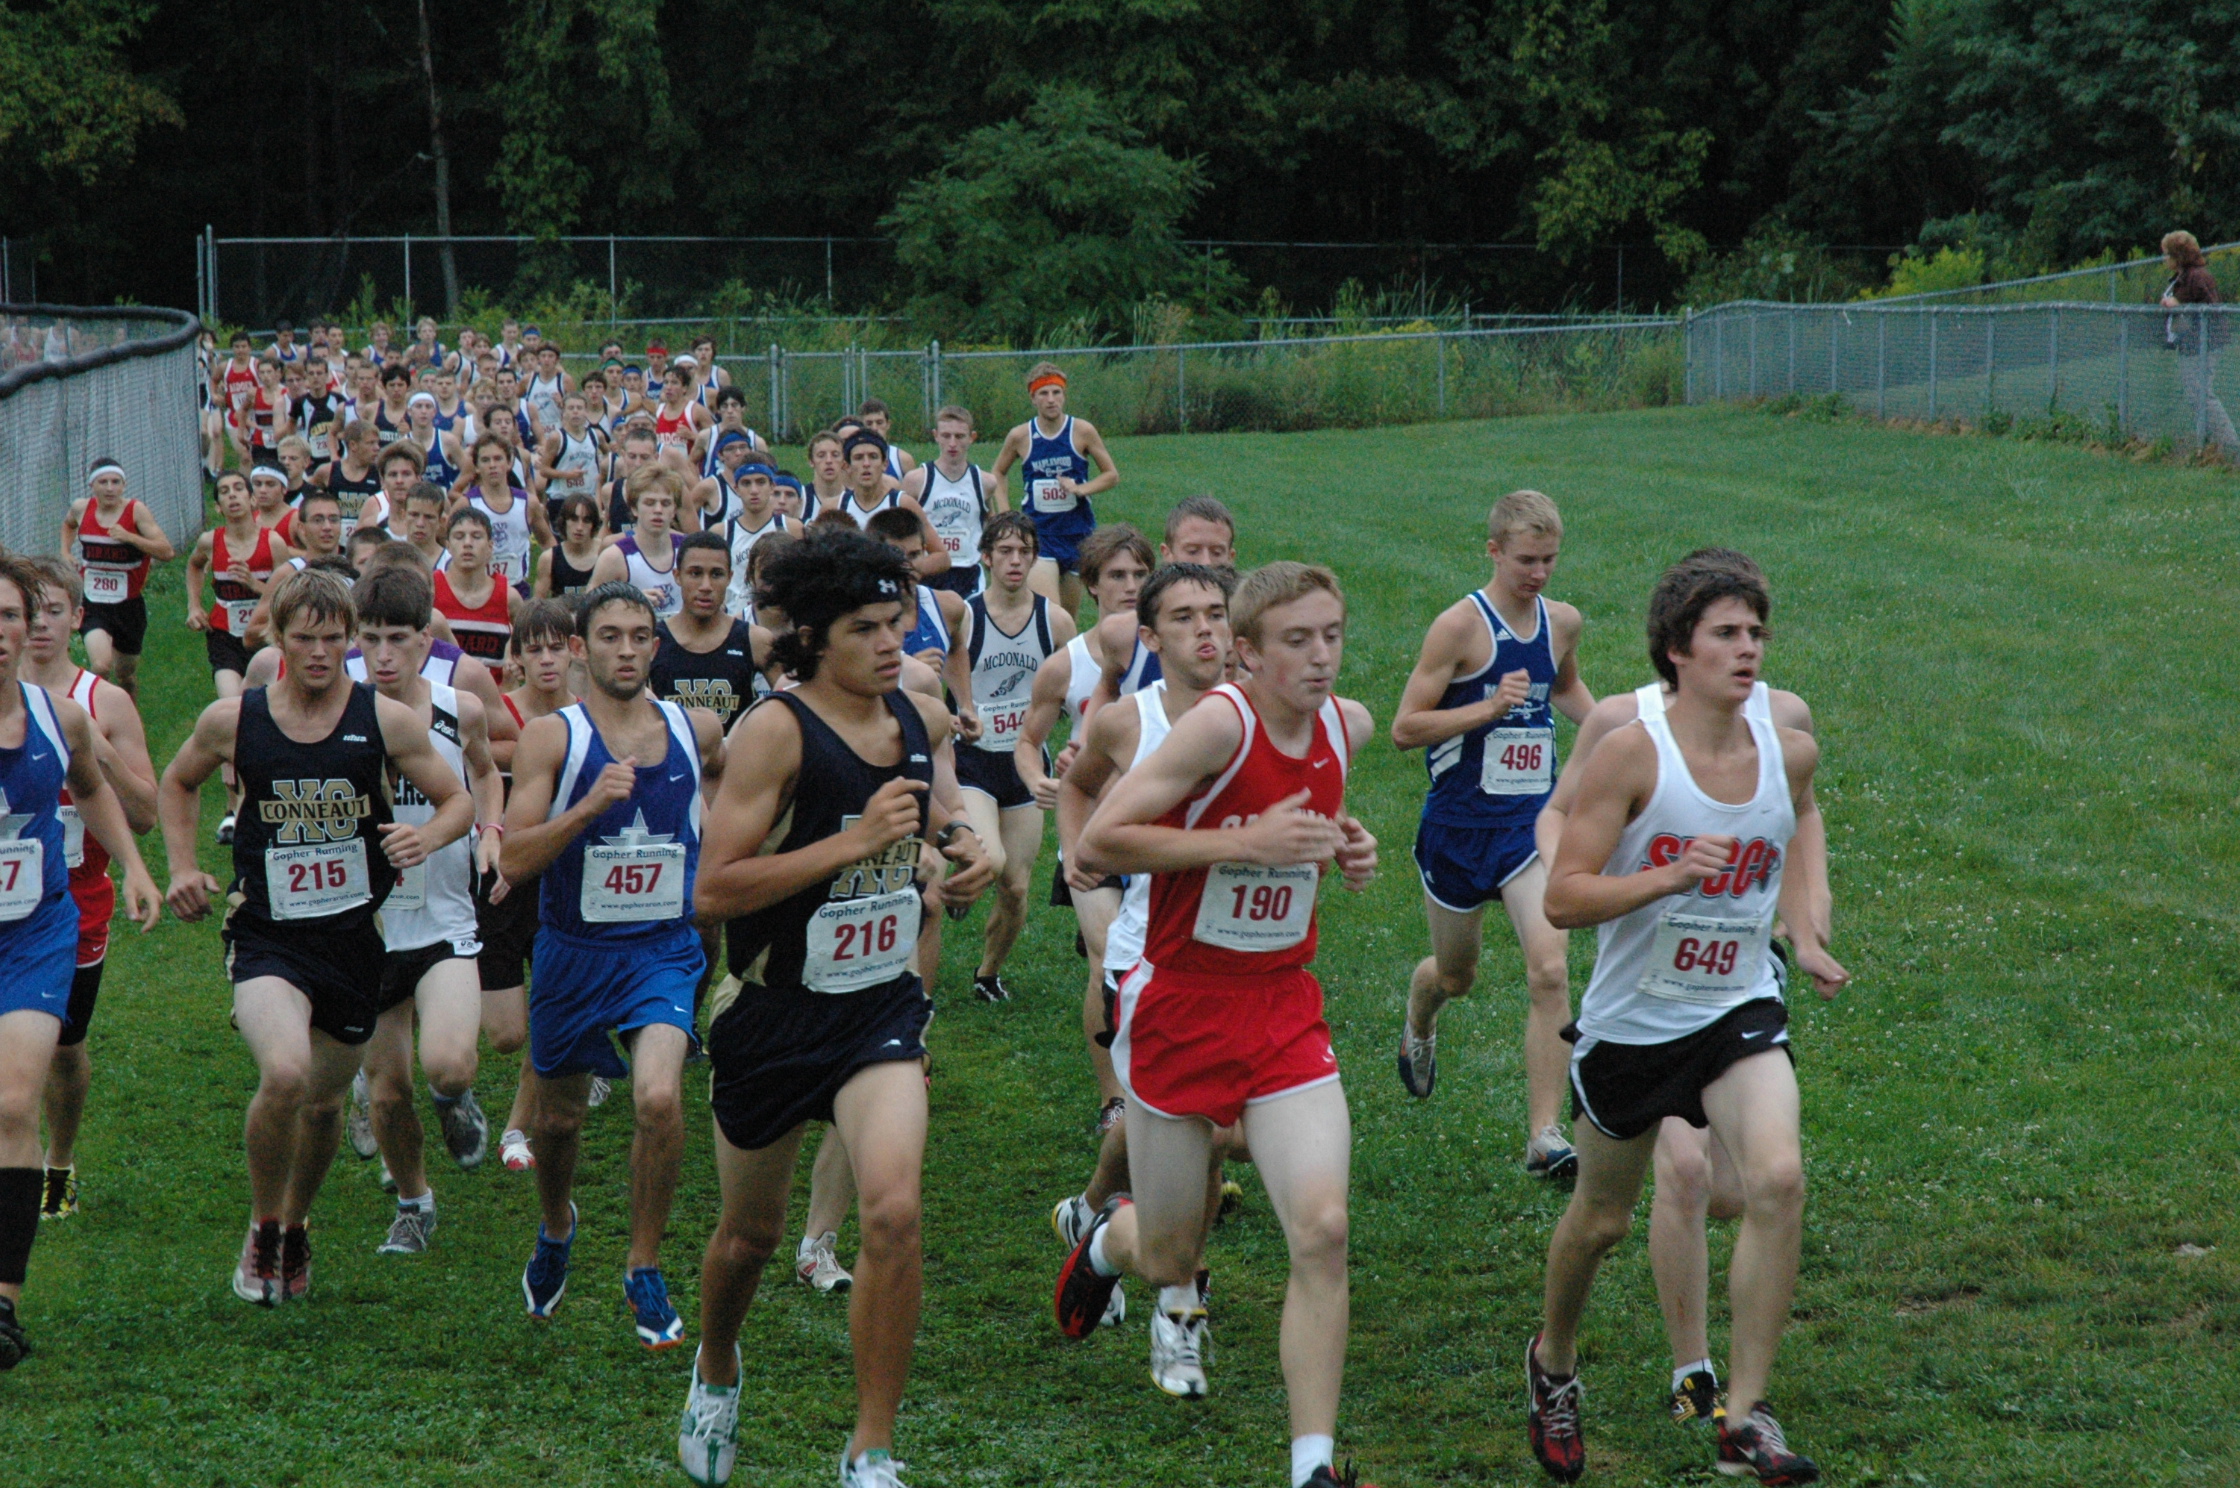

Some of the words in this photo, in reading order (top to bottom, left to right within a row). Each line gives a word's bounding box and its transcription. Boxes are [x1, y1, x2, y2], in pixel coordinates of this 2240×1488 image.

[1042, 487, 1067, 501] 503
[942, 537, 960, 552] 56
[93, 577, 118, 591] 280
[1500, 743, 1542, 771] 496
[264, 798, 366, 820] CONNEAUT
[0, 844, 35, 855] unning
[273, 849, 310, 861] Gopher
[315, 843, 359, 857] Running
[592, 850, 632, 861] Gopher
[636, 848, 678, 859] Running
[288, 858, 347, 893] 215
[604, 863, 663, 895] 457
[1219, 865, 1263, 878] Gopher
[1267, 867, 1312, 881] Running
[289, 891, 365, 907] www.gopherarun.com
[601, 900, 678, 911] www.gopherarun.com
[819, 905, 866, 921] Gopher
[870, 892, 914, 912] Running
[1231, 884, 1293, 921] 190
[1667, 917, 1712, 931] Gopher
[1716, 922, 1758, 935] Running
[833, 914, 898, 961] 216
[1673, 937, 1739, 976] 649
